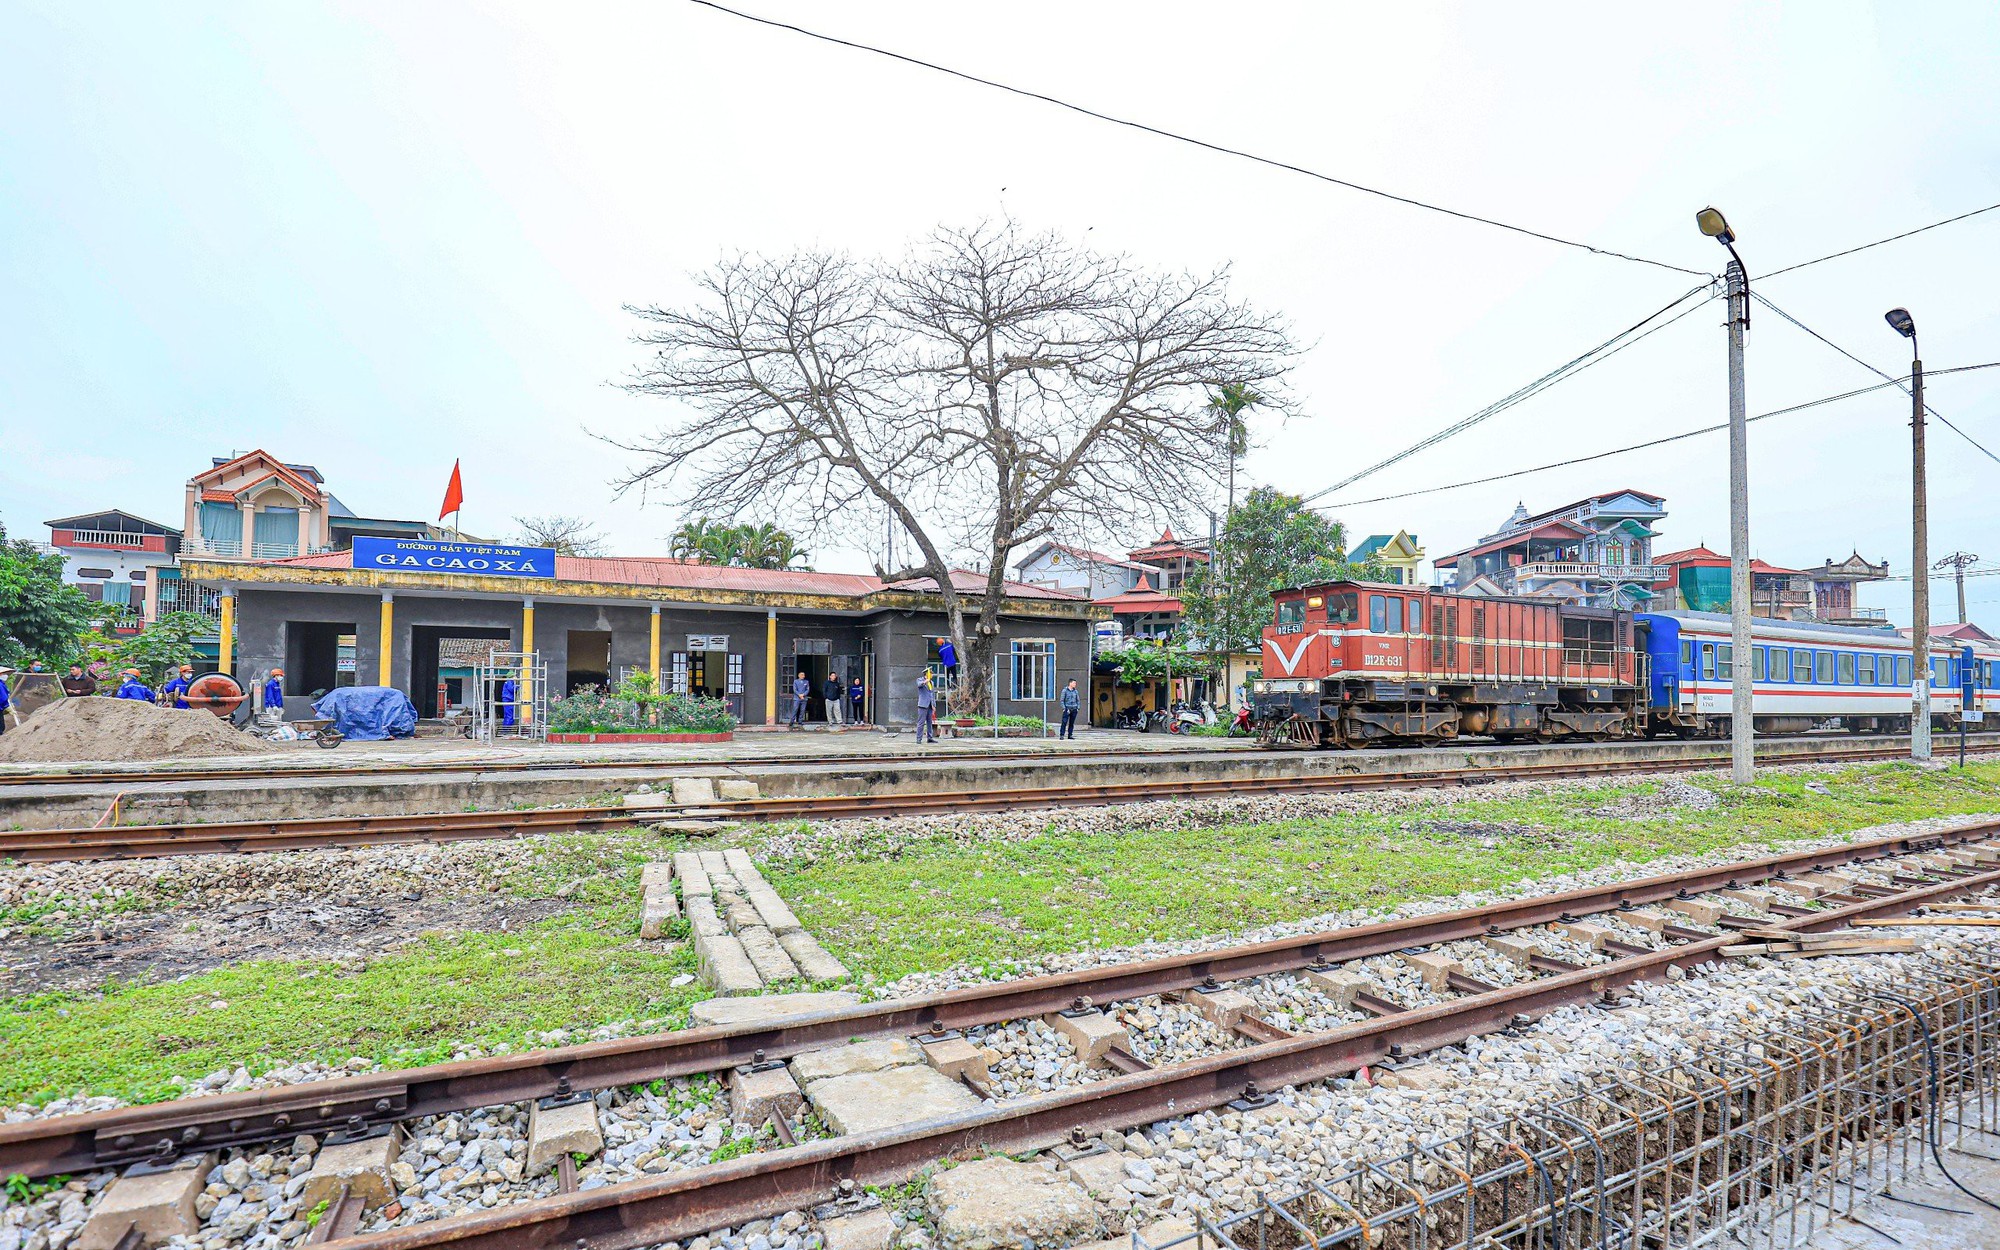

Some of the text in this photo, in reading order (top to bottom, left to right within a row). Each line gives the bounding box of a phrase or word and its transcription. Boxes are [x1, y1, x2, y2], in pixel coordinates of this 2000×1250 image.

[396, 542, 437, 551] ĐƯỜNG
[465, 546, 492, 555] VIỆT
[375, 554, 538, 572] GA CAO XÁ
[1364, 654, 1402, 666] D12E-631
